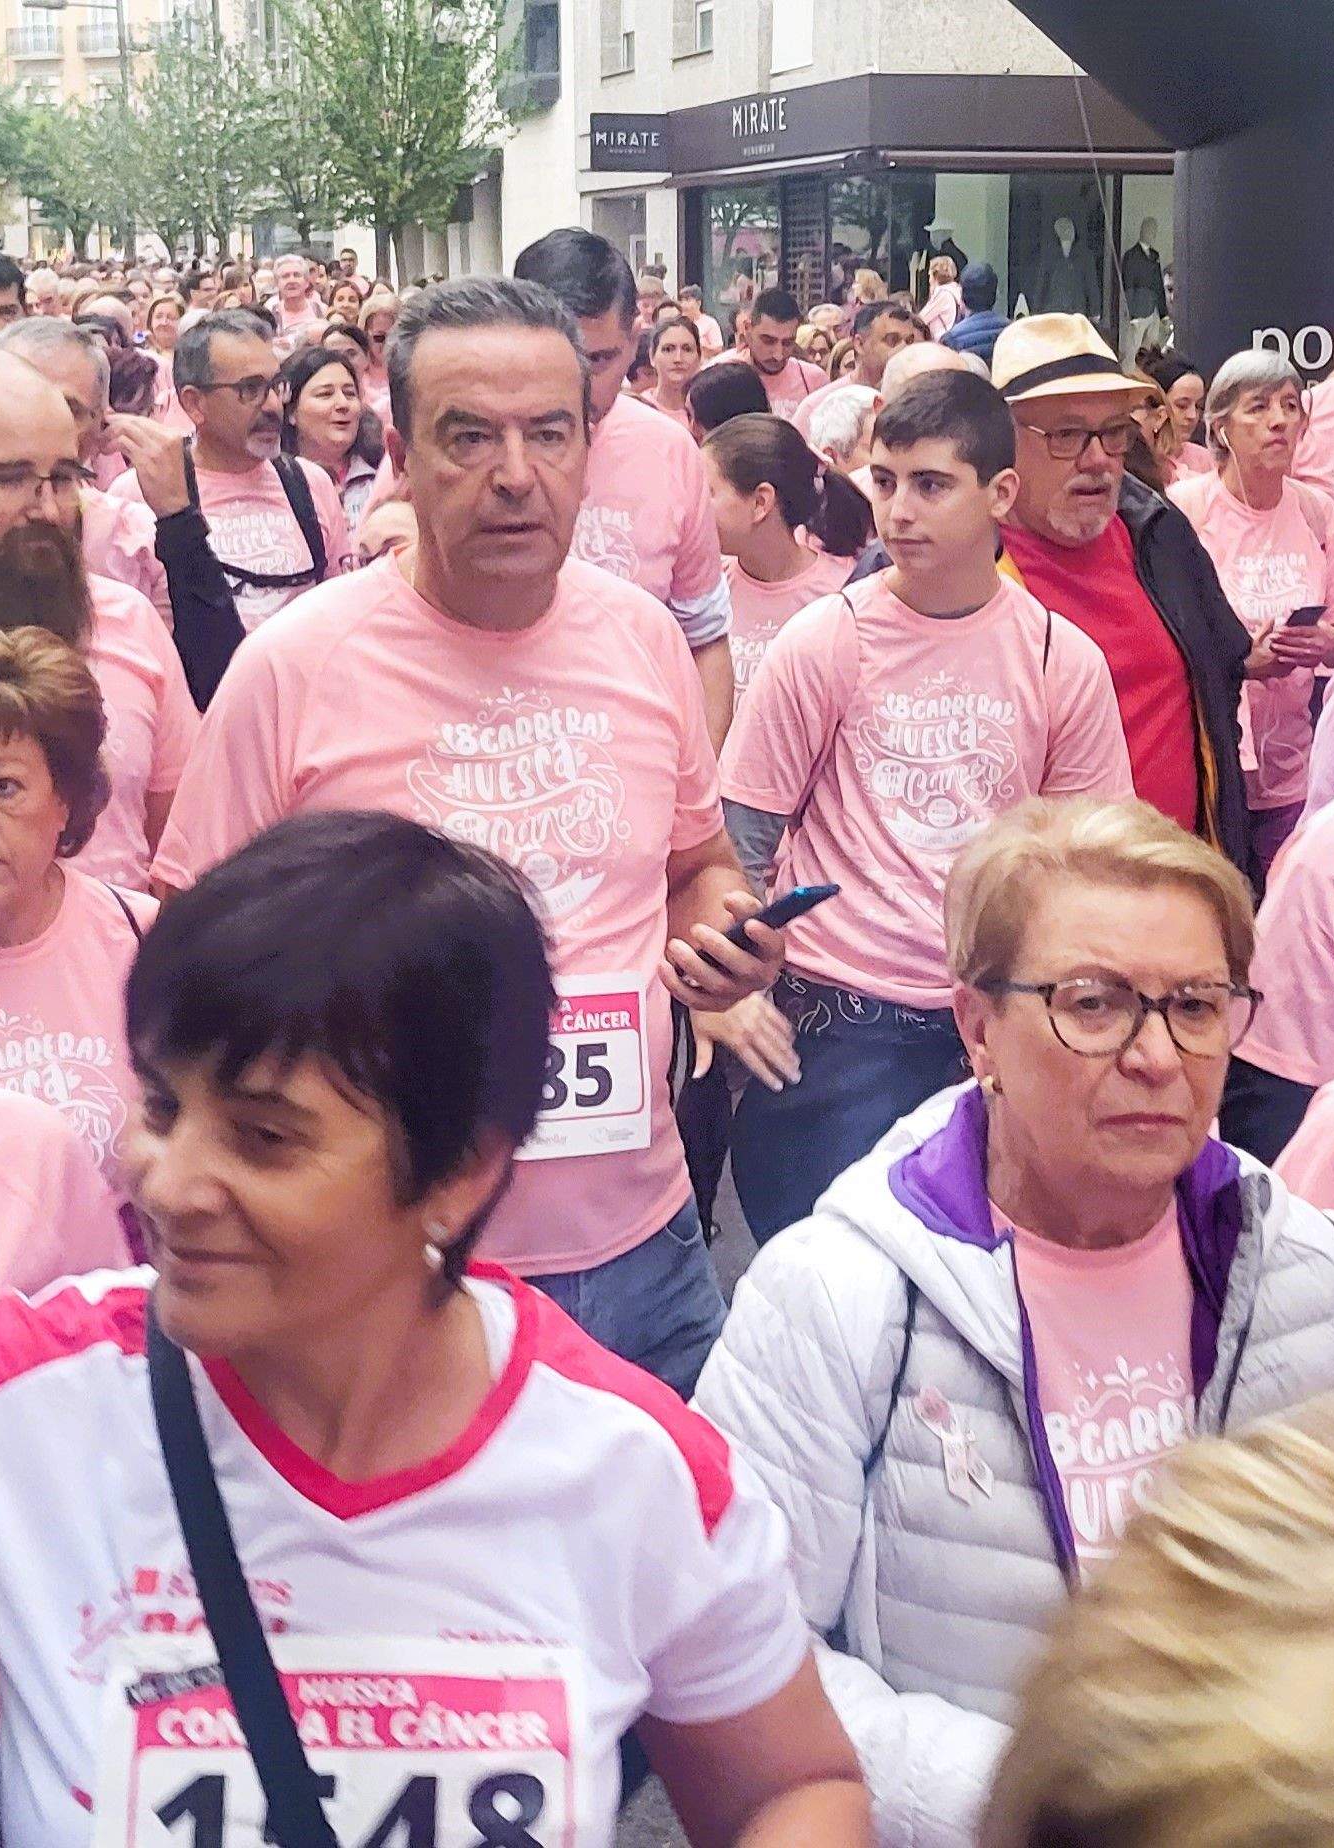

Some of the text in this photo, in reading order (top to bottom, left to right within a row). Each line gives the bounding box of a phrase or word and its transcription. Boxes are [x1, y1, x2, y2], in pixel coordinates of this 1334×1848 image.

[732, 97, 787, 137] MIRATE
[595, 132, 661, 147] MIRATE
[562, 1009, 632, 1032] CÁNCER
[156, 1706, 331, 1749] CONA
[388, 1698, 554, 1749] CÁNCER
[152, 1772, 547, 1848] 148
